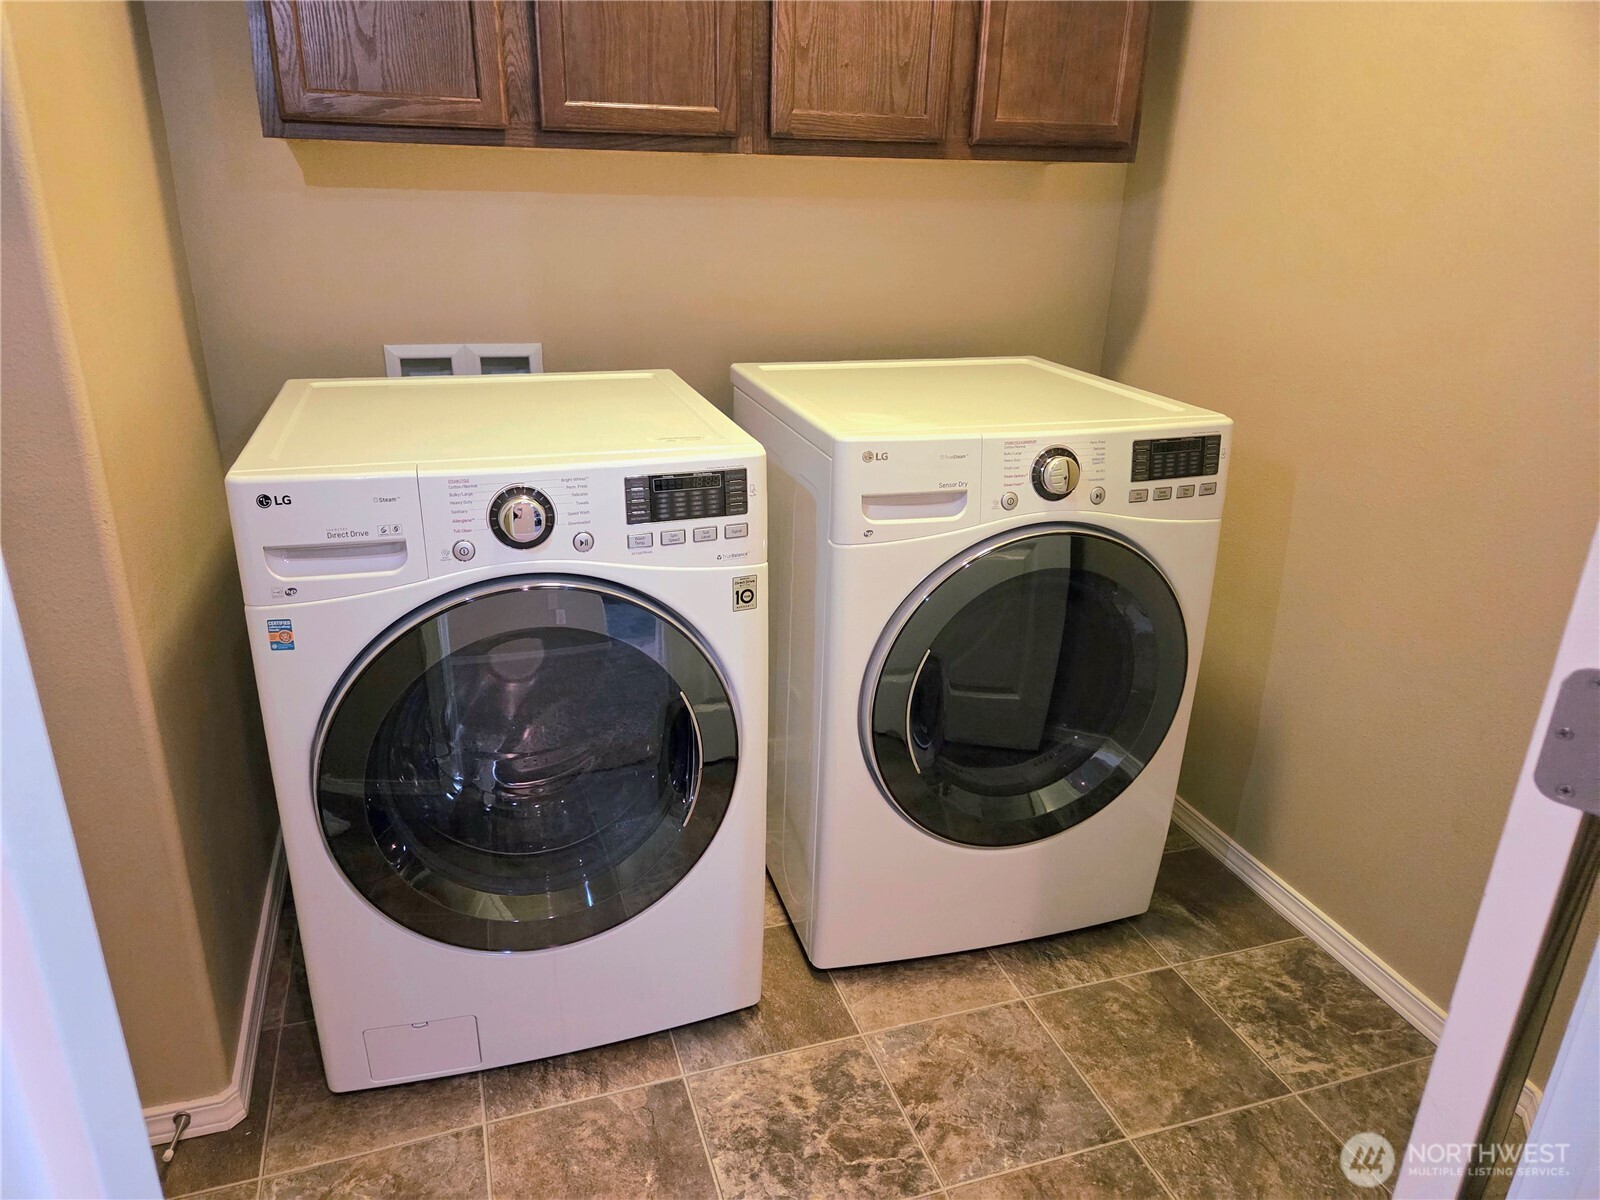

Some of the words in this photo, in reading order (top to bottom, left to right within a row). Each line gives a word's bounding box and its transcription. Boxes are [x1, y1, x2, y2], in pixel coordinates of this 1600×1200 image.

[875, 452, 889, 461] LG
[274, 495, 292, 506] LG
[326, 531, 349, 539] Direct
[350, 530, 369, 538] Drive
[735, 588, 754, 605] 10
